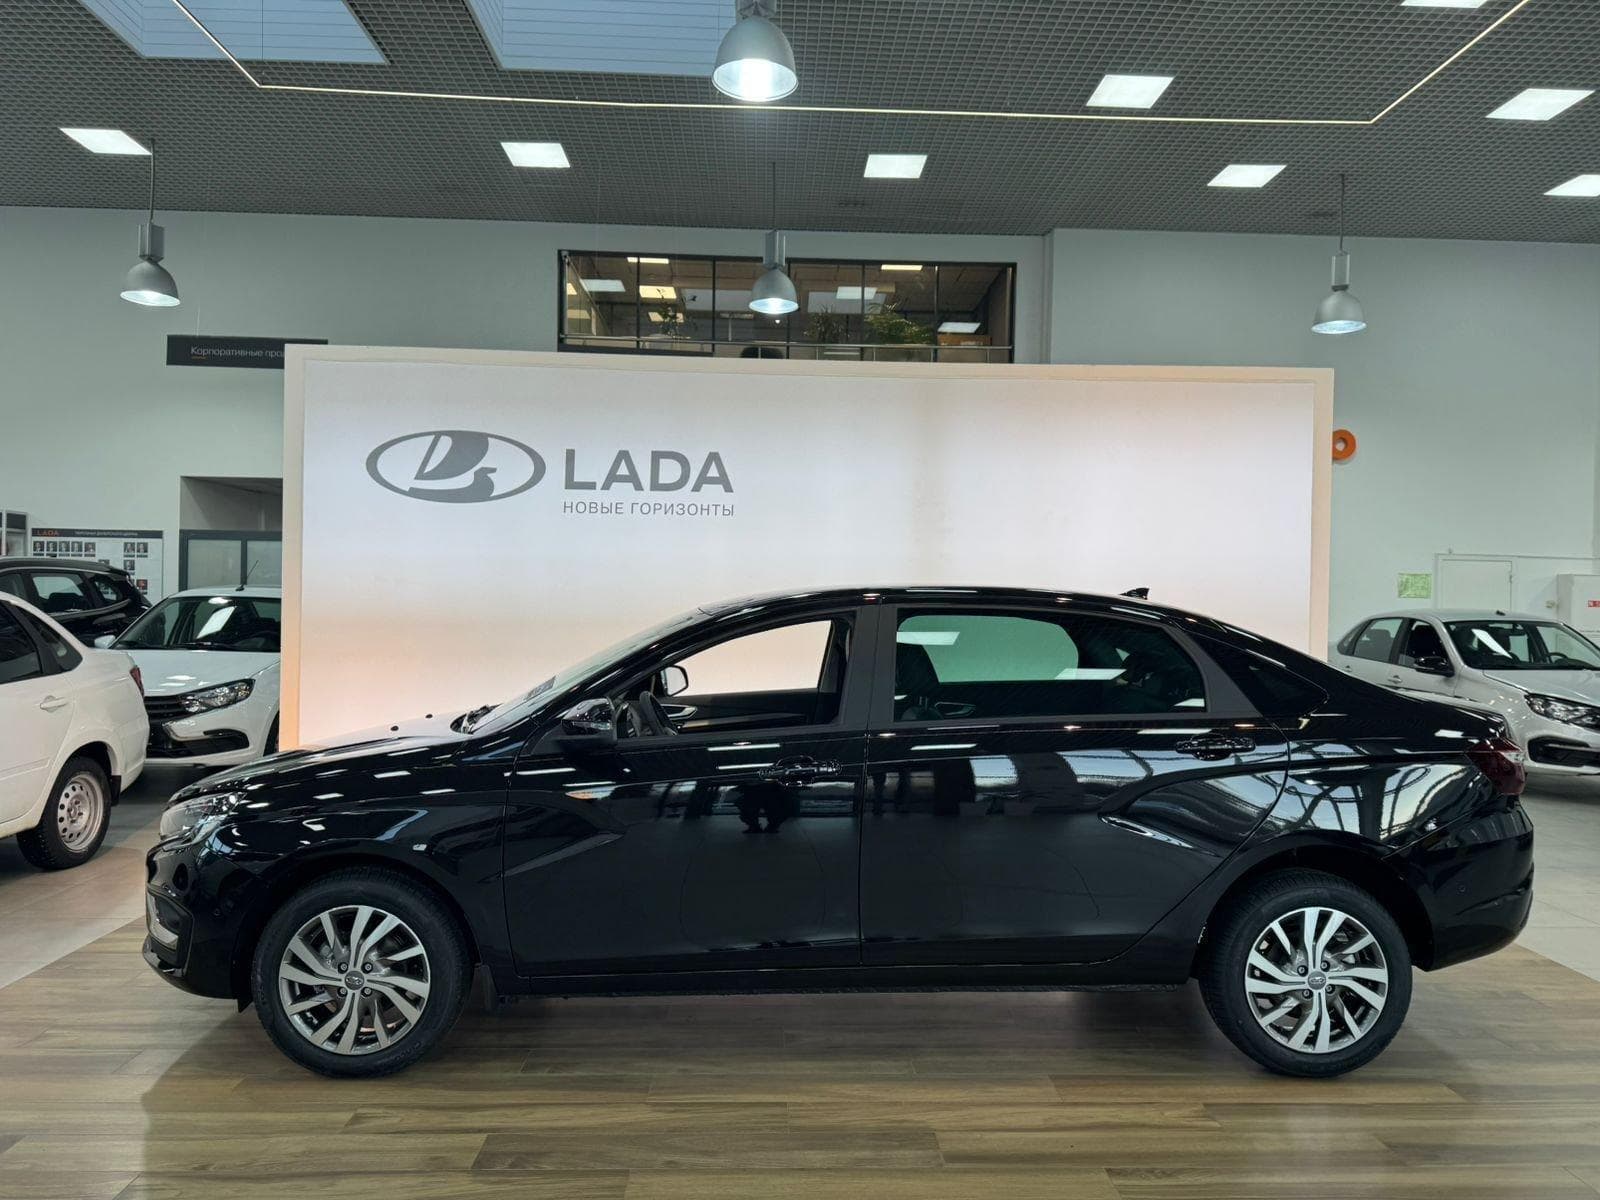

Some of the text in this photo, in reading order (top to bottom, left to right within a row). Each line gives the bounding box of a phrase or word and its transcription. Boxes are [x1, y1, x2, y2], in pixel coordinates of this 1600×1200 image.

[191, 347, 263, 357] Корпоративные
[564, 448, 734, 493] LADA
[563, 501, 735, 517] НОВЫЕ ГОРИЗОНТЫ
